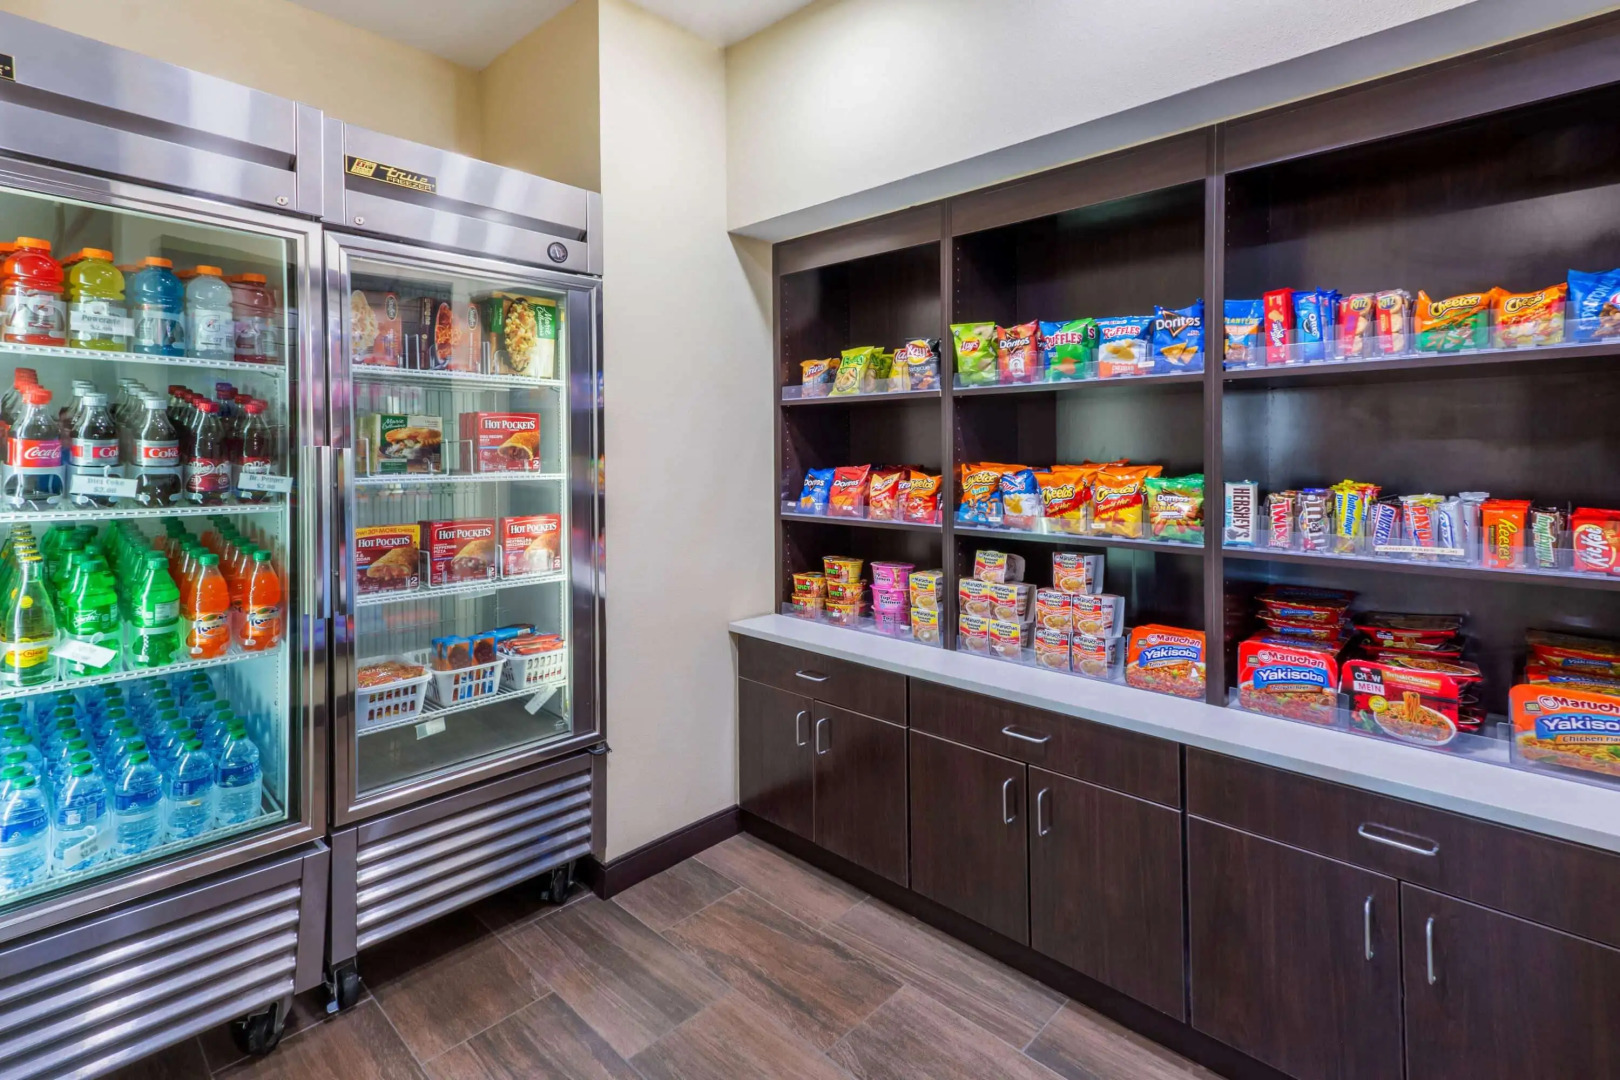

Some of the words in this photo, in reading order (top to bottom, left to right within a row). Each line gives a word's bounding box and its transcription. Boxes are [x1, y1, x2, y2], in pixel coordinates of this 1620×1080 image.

[1351, 300, 1368, 311] RITZ
[1379, 297, 1396, 309] RITZ
[1429, 295, 1481, 318] Cheetos
[1504, 293, 1545, 313] Cheetos
[543, 309, 553, 336] Marie
[1155, 316, 1201, 331] Doritos
[1308, 313, 1320, 338] OREO
[1103, 325, 1141, 339] RUFFLES
[999, 336, 1031, 349] Doritos
[1045, 332, 1083, 350] RUFFLES
[484, 420, 502, 430] HOT
[502, 420, 536, 430] POCKETS
[833, 478, 860, 488] Doritos
[963, 471, 1000, 493] Cheetos
[1041, 485, 1076, 507] Cheetos
[1096, 482, 1138, 504] Cheetos
[1344, 493, 1360, 536] Butterfinger
[438, 530, 456, 540] HOT
[456, 527, 492, 539] POCKETS
[510, 525, 526, 534] HOT
[526, 521, 557, 533] POCKETS
[358, 539, 375, 548] HOT
[375, 536, 410, 547] POCKETS
[1498, 517, 1518, 562] Reese's
[410, 576, 418, 585] 2
[1156, 634, 1201, 647] Maruchan
[1144, 647, 1198, 660] Yakisoba
[1267, 651, 1326, 668] Maruchan
[1257, 669, 1324, 683] Yakisoba
[1354, 672, 1382, 682] CHOW
[1358, 682, 1382, 692] MEIN
[1562, 735, 1603, 743] Chicken
